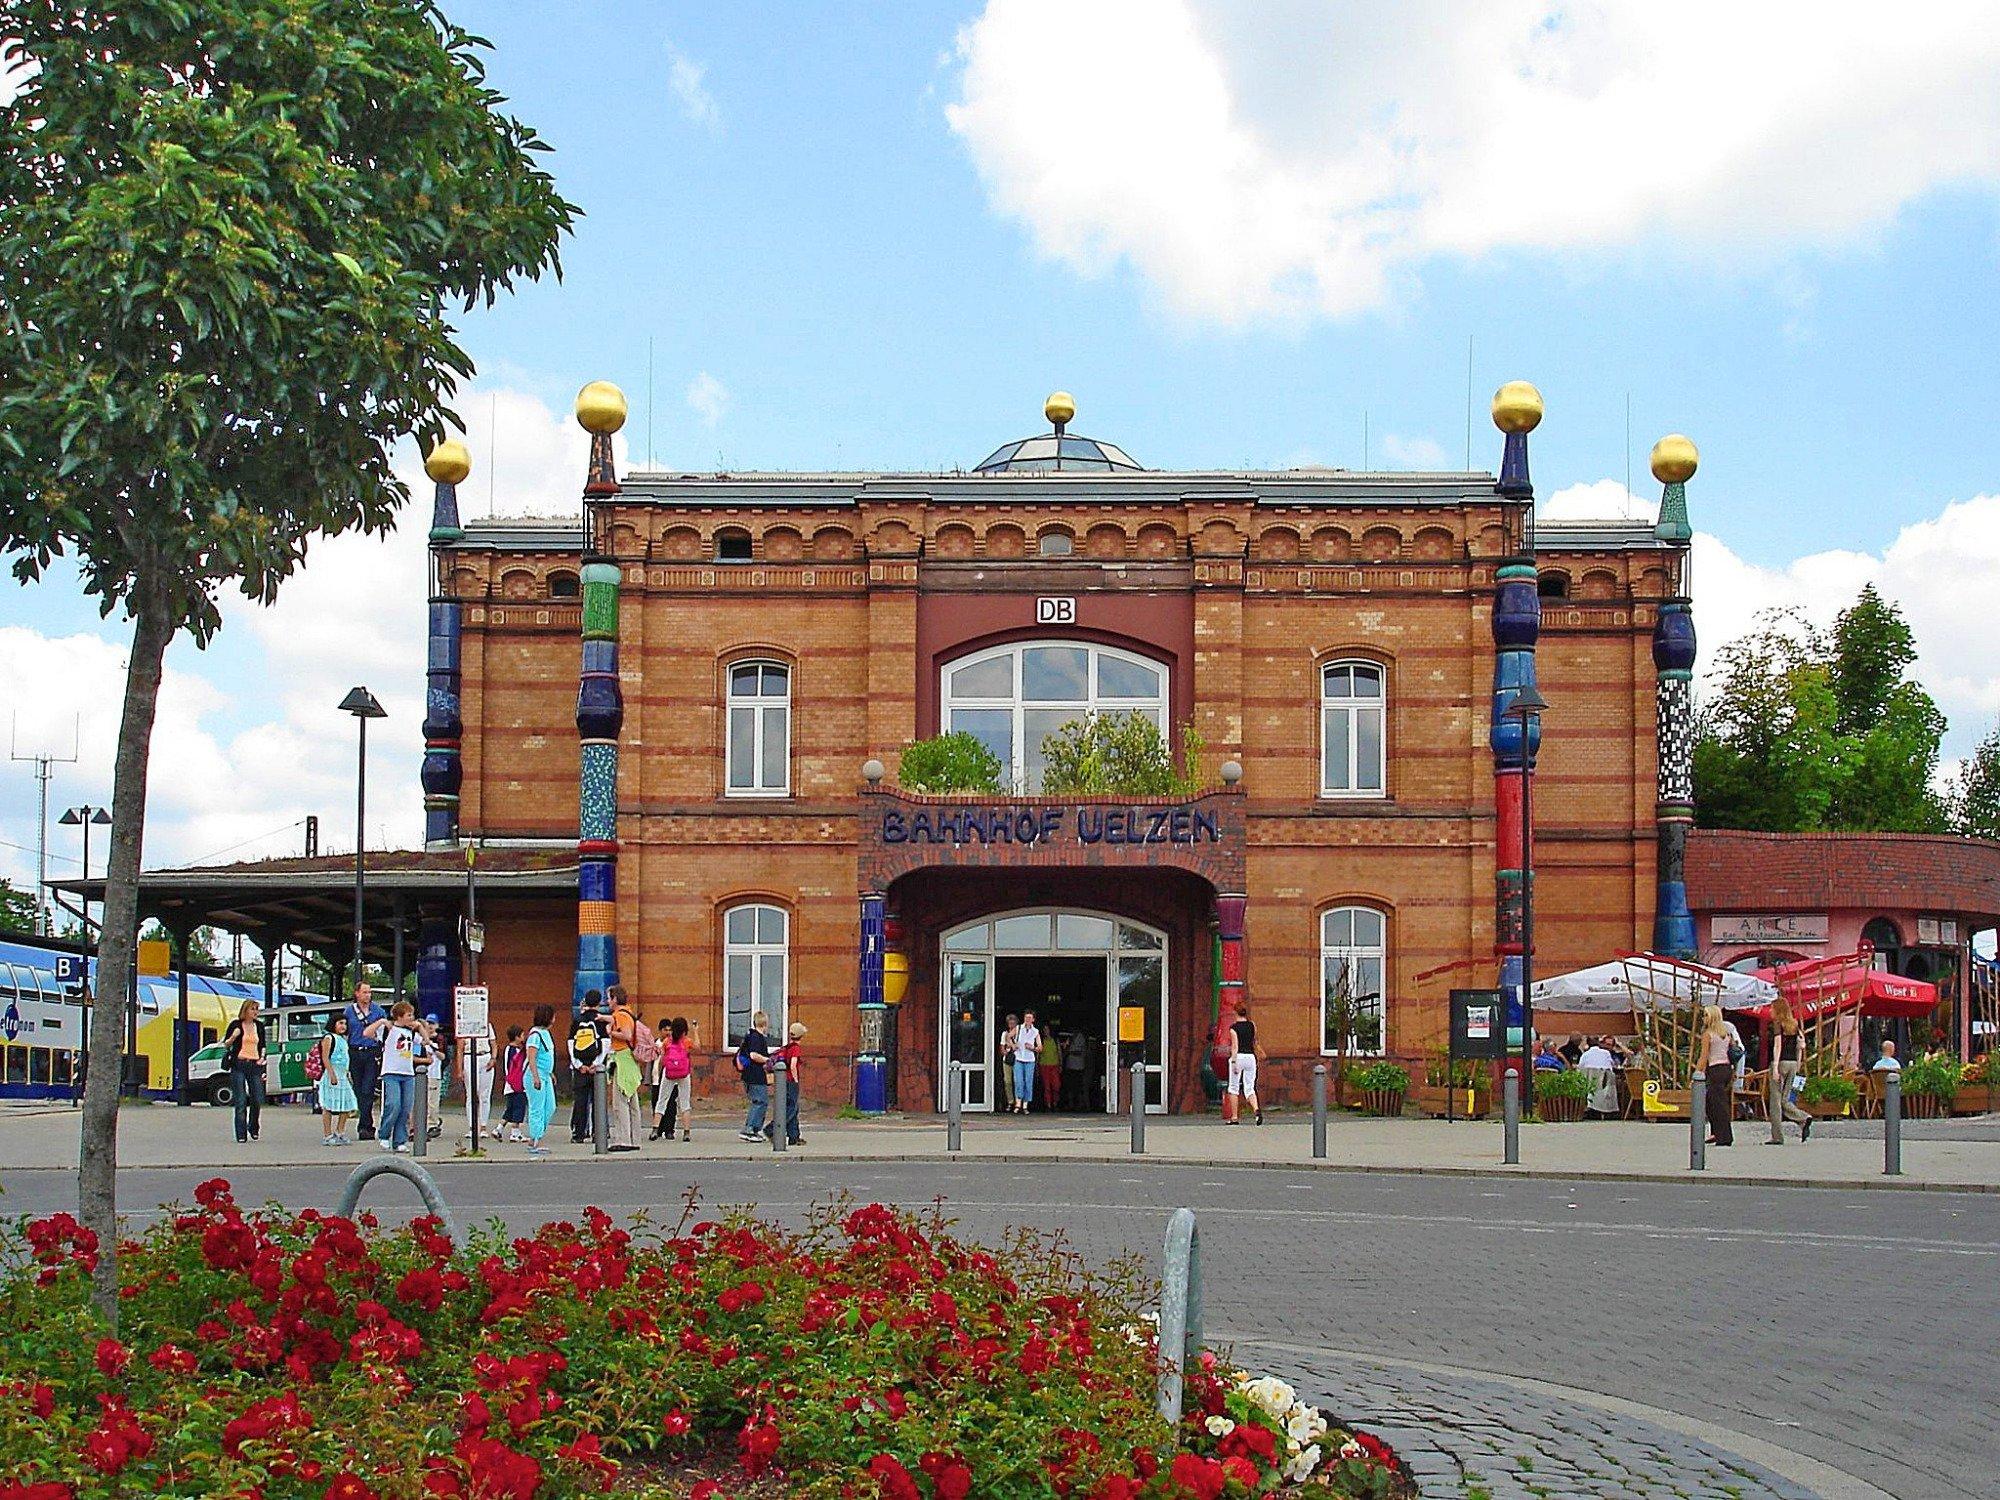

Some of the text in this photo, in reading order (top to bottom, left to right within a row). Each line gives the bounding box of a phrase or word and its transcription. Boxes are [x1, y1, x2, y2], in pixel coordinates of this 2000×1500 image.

[1040, 600, 1072, 621] DB
[883, 808, 1220, 844] BAHNHOF UELZEN
[58, 959, 71, 978] B
[1884, 984, 1907, 997] West
